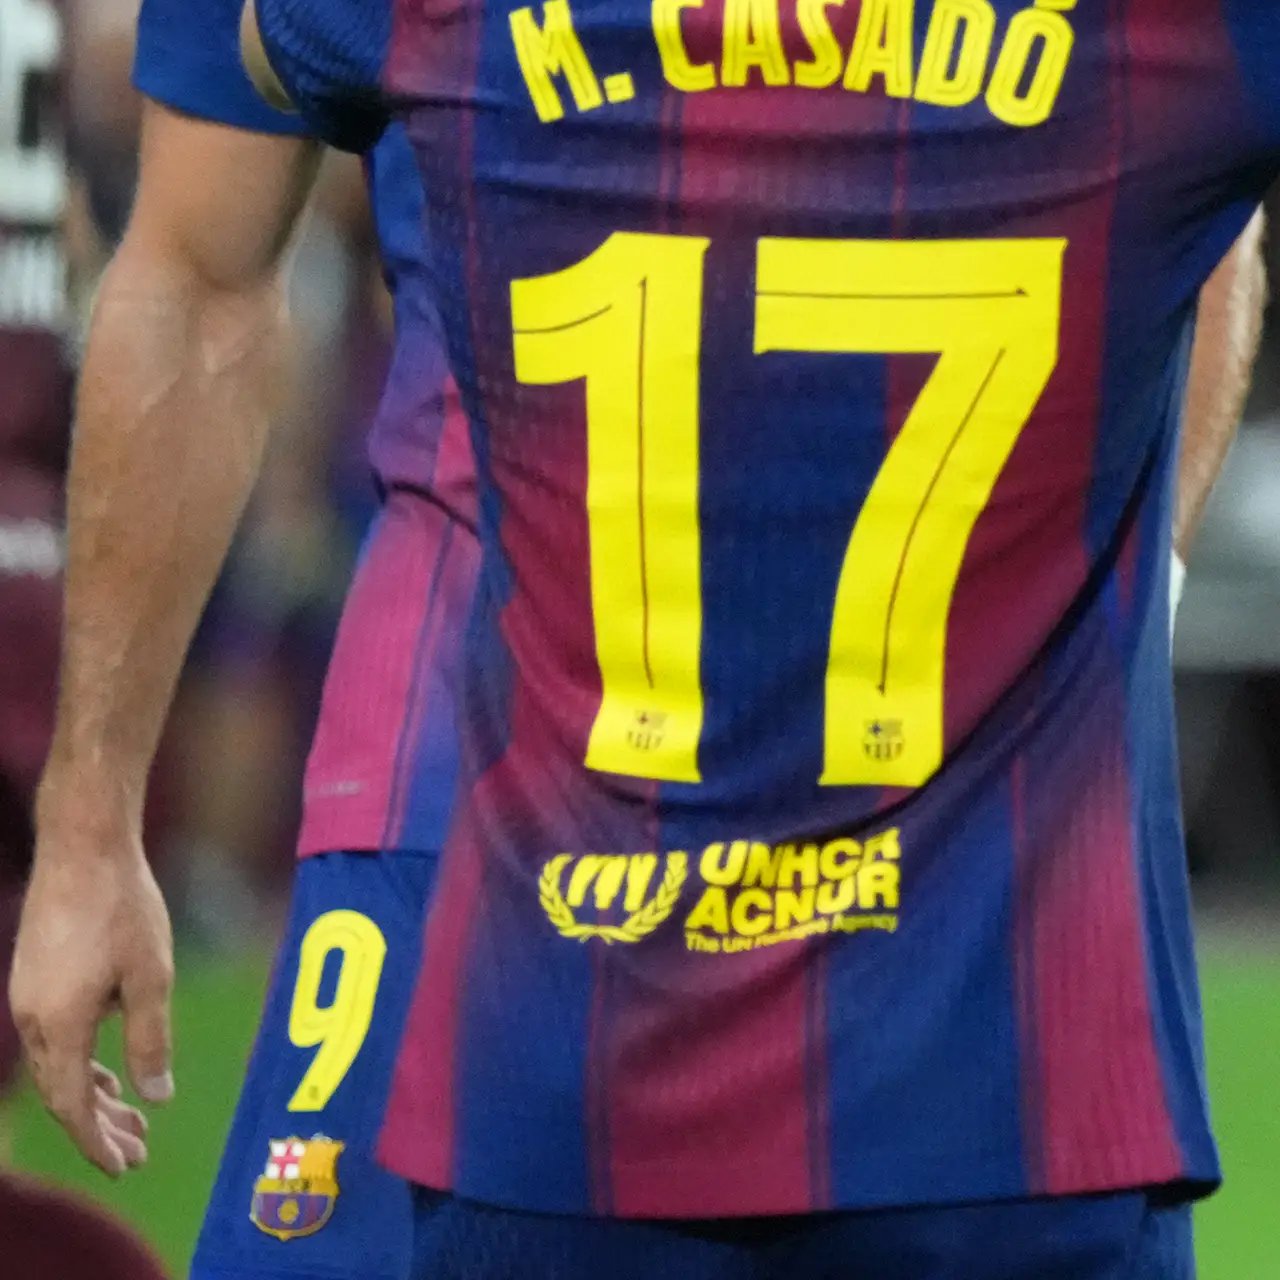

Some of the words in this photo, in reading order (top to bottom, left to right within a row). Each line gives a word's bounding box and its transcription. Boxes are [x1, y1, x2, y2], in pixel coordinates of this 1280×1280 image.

[509, 230, 1068, 787] 17
[685, 862, 900, 937] ACNUR
[287, 908, 388, 1112] 9
